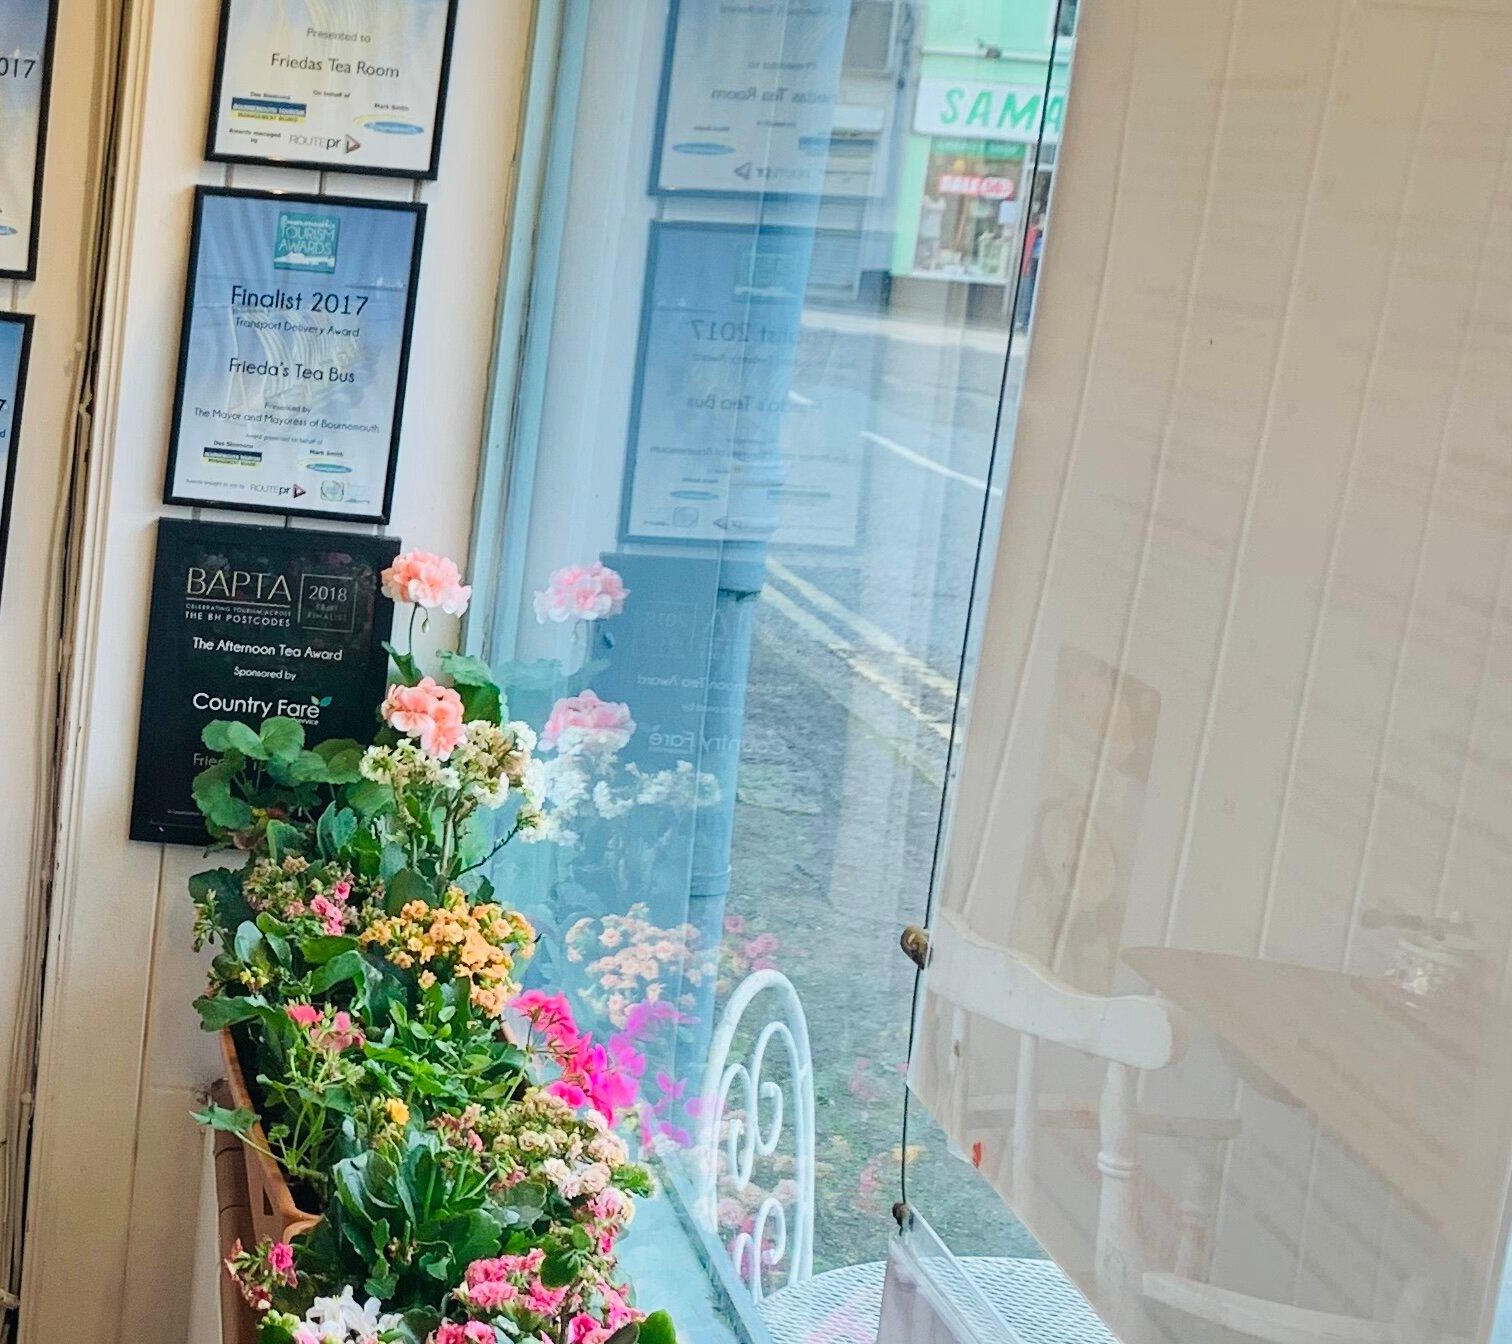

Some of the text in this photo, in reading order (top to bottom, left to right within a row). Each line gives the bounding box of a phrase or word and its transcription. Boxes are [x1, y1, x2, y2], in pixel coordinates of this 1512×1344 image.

[307, 28, 371, 43] Presented to
[271, 53, 400, 78] Friedas Tea Room
[279, 239, 332, 256] AWARDS
[232, 286, 369, 315] Finalist 2017
[236, 317, 281, 331] Transport
[328, 326, 360, 337] Award
[229, 358, 354, 383] Frieda's Tea Bus
[195, 407, 210, 417] The
[212, 409, 241, 421] Mayor
[245, 413, 261, 422] and
[265, 415, 306, 427] Mayoress
[321, 419, 379, 433] Bournemouth
[187, 567, 348, 602] BAPTA 2018
[185, 611, 290, 627] THE BH POSTCODES
[193, 637, 343, 661] The Afternoon Tea Award
[234, 666, 296, 681] Sponsored by
[193, 693, 320, 718] Country Fare
